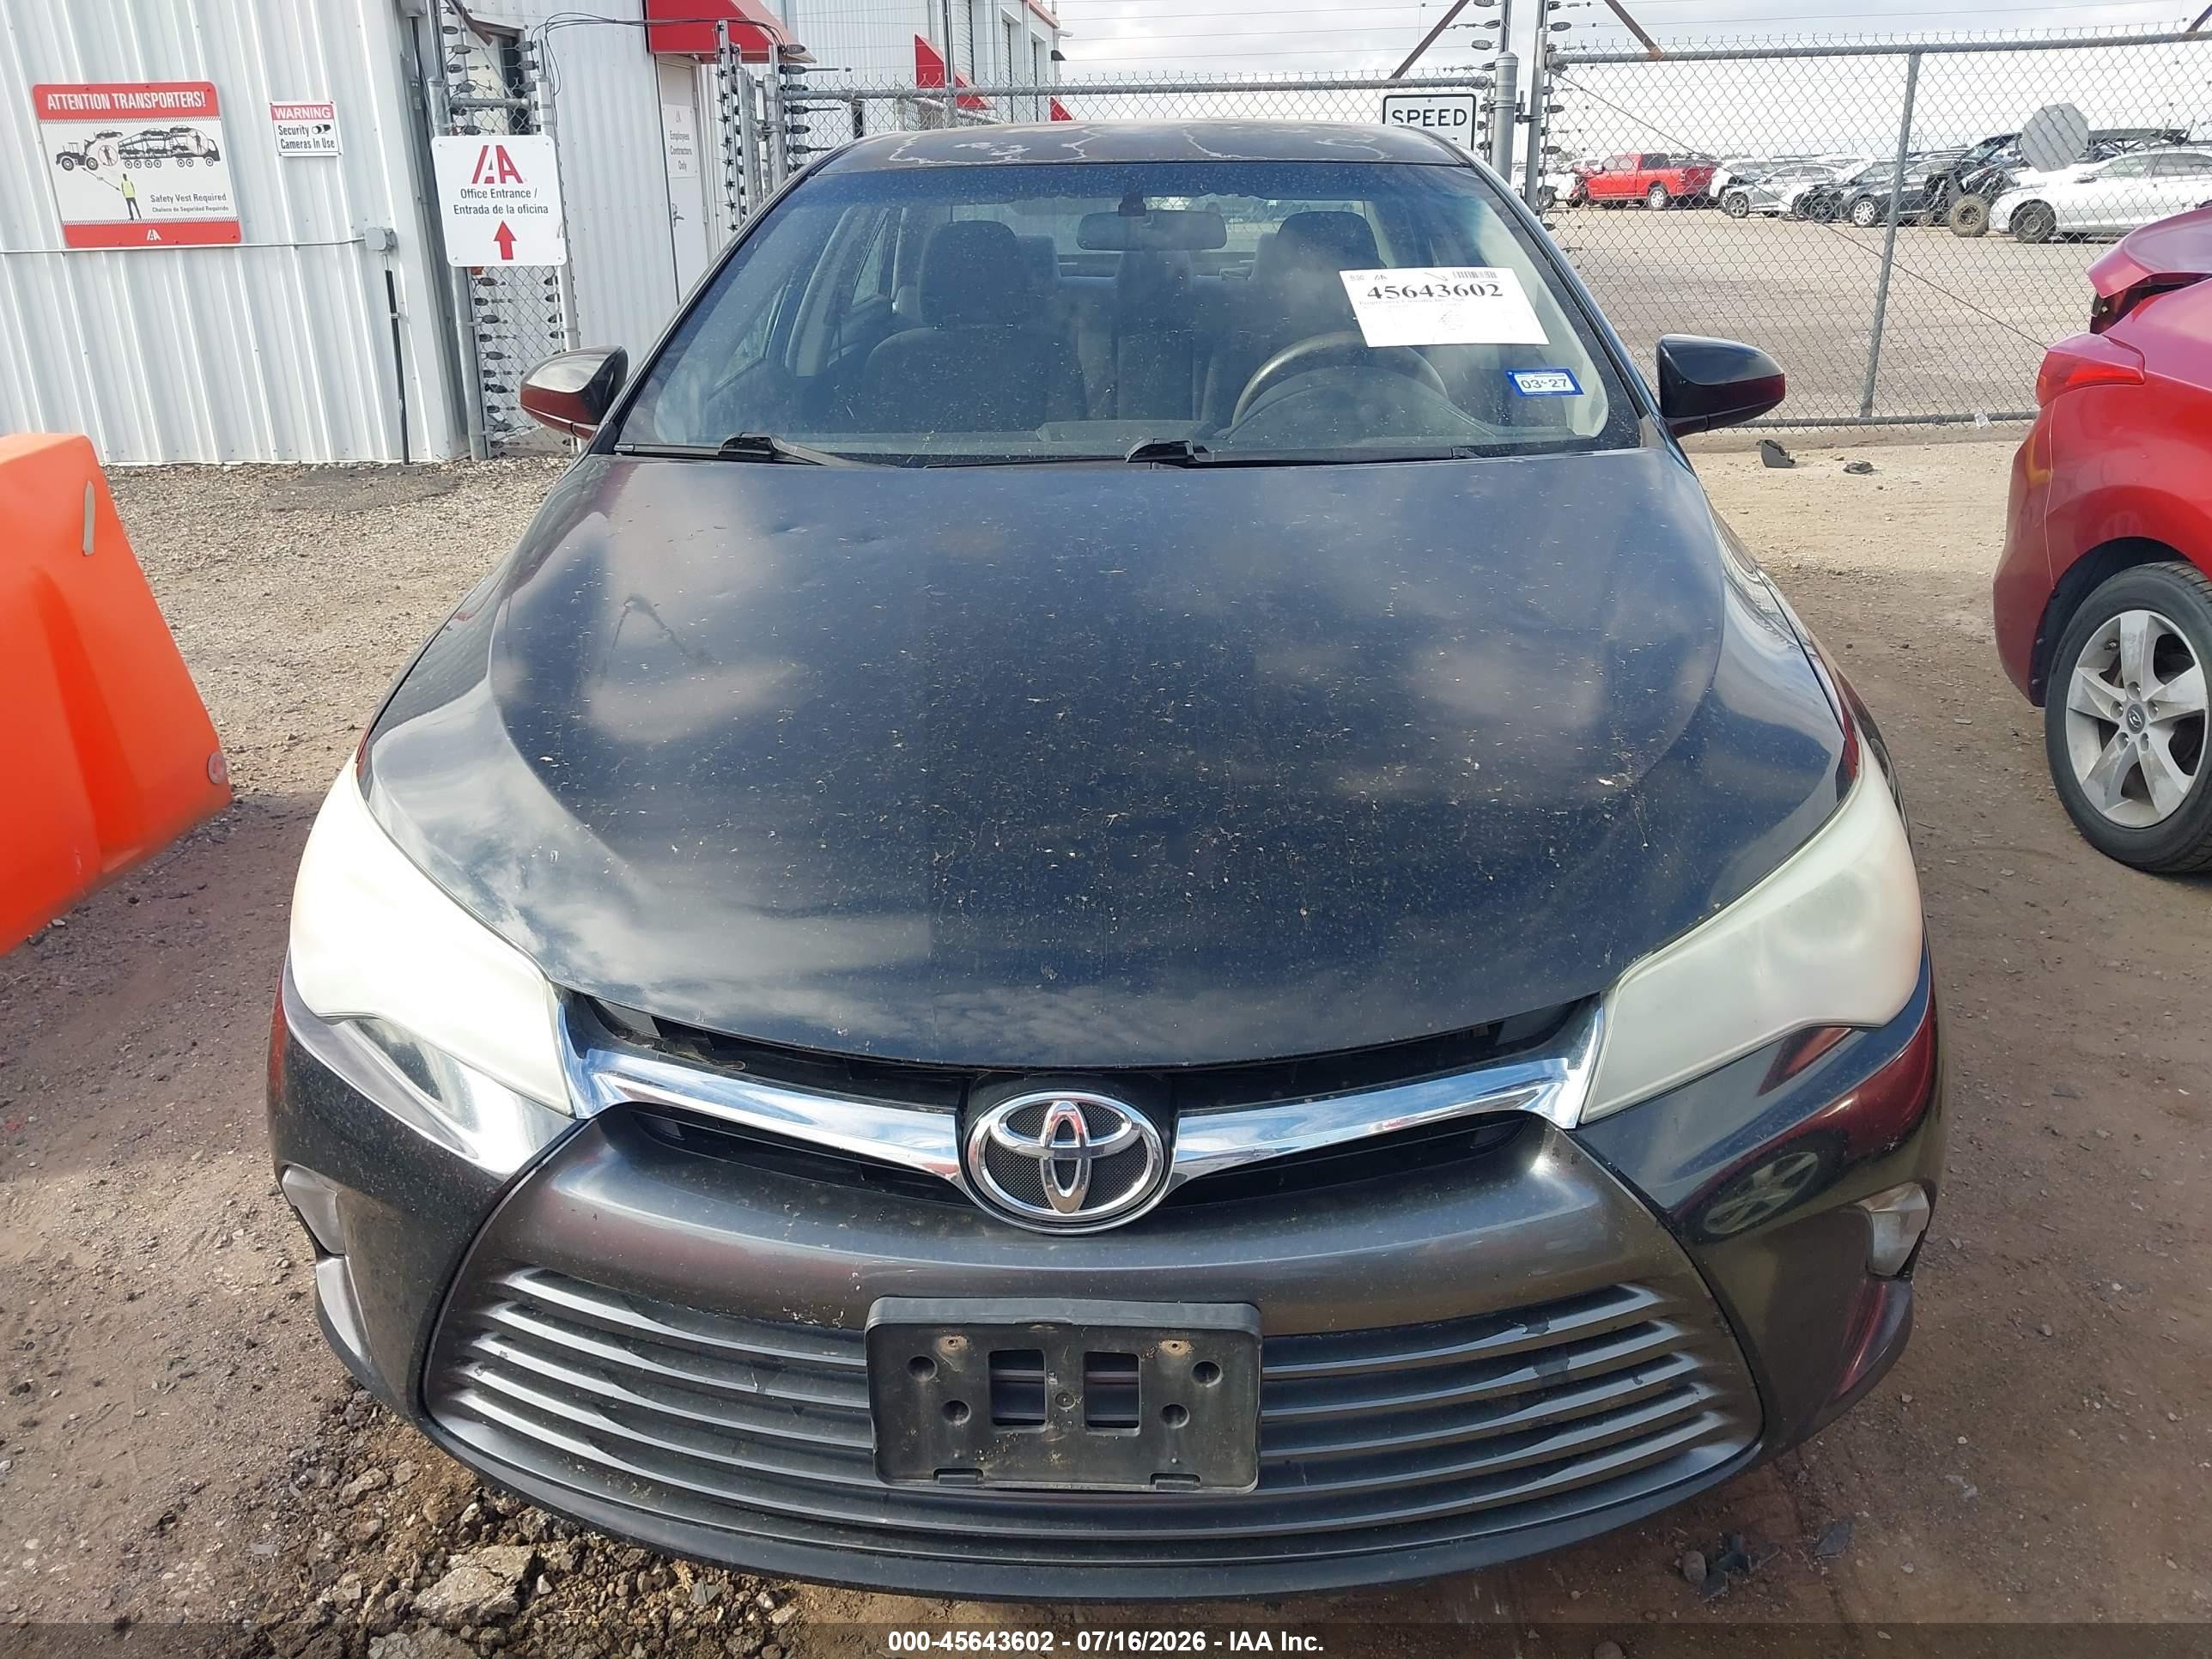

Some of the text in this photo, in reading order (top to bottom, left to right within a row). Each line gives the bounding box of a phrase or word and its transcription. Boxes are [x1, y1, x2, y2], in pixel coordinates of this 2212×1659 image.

[47, 91, 206, 111] ATTENTION TRANSPORTERS!
[274, 106, 331, 119] WARNING
[1391, 108, 1468, 127] SPEED
[277, 125, 309, 137] Security
[280, 137, 335, 149] Cameras In Use
[150, 193, 227, 204] Safety Vest Required
[460, 188, 488, 199] Office
[490, 188, 532, 199] Entrance
[453, 204, 550, 215] Entrada de la oficina
[1366, 283, 1504, 300] 45643602
